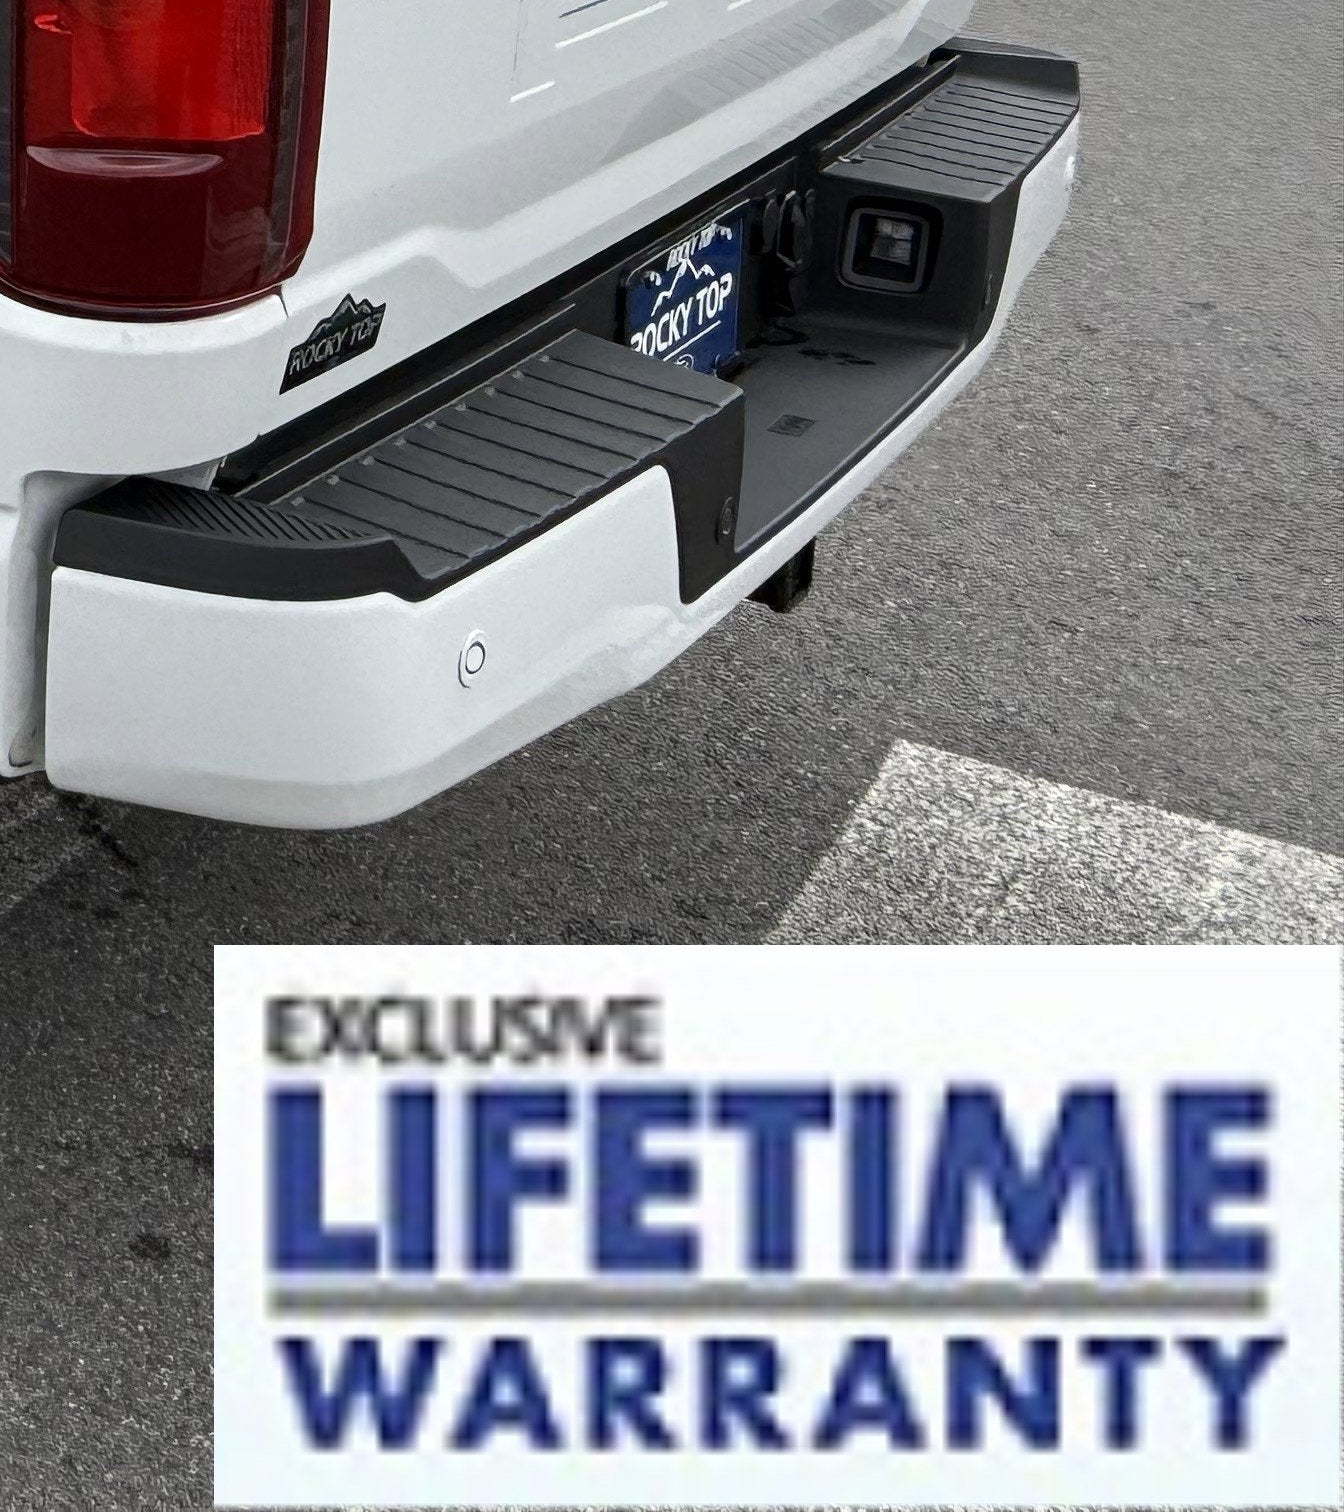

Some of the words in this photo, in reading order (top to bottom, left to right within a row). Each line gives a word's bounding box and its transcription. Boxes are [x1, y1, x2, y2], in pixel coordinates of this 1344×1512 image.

[696, 273, 733, 326] TOP
[290, 327, 349, 376] ROCKY
[351, 313, 383, 347] TOP
